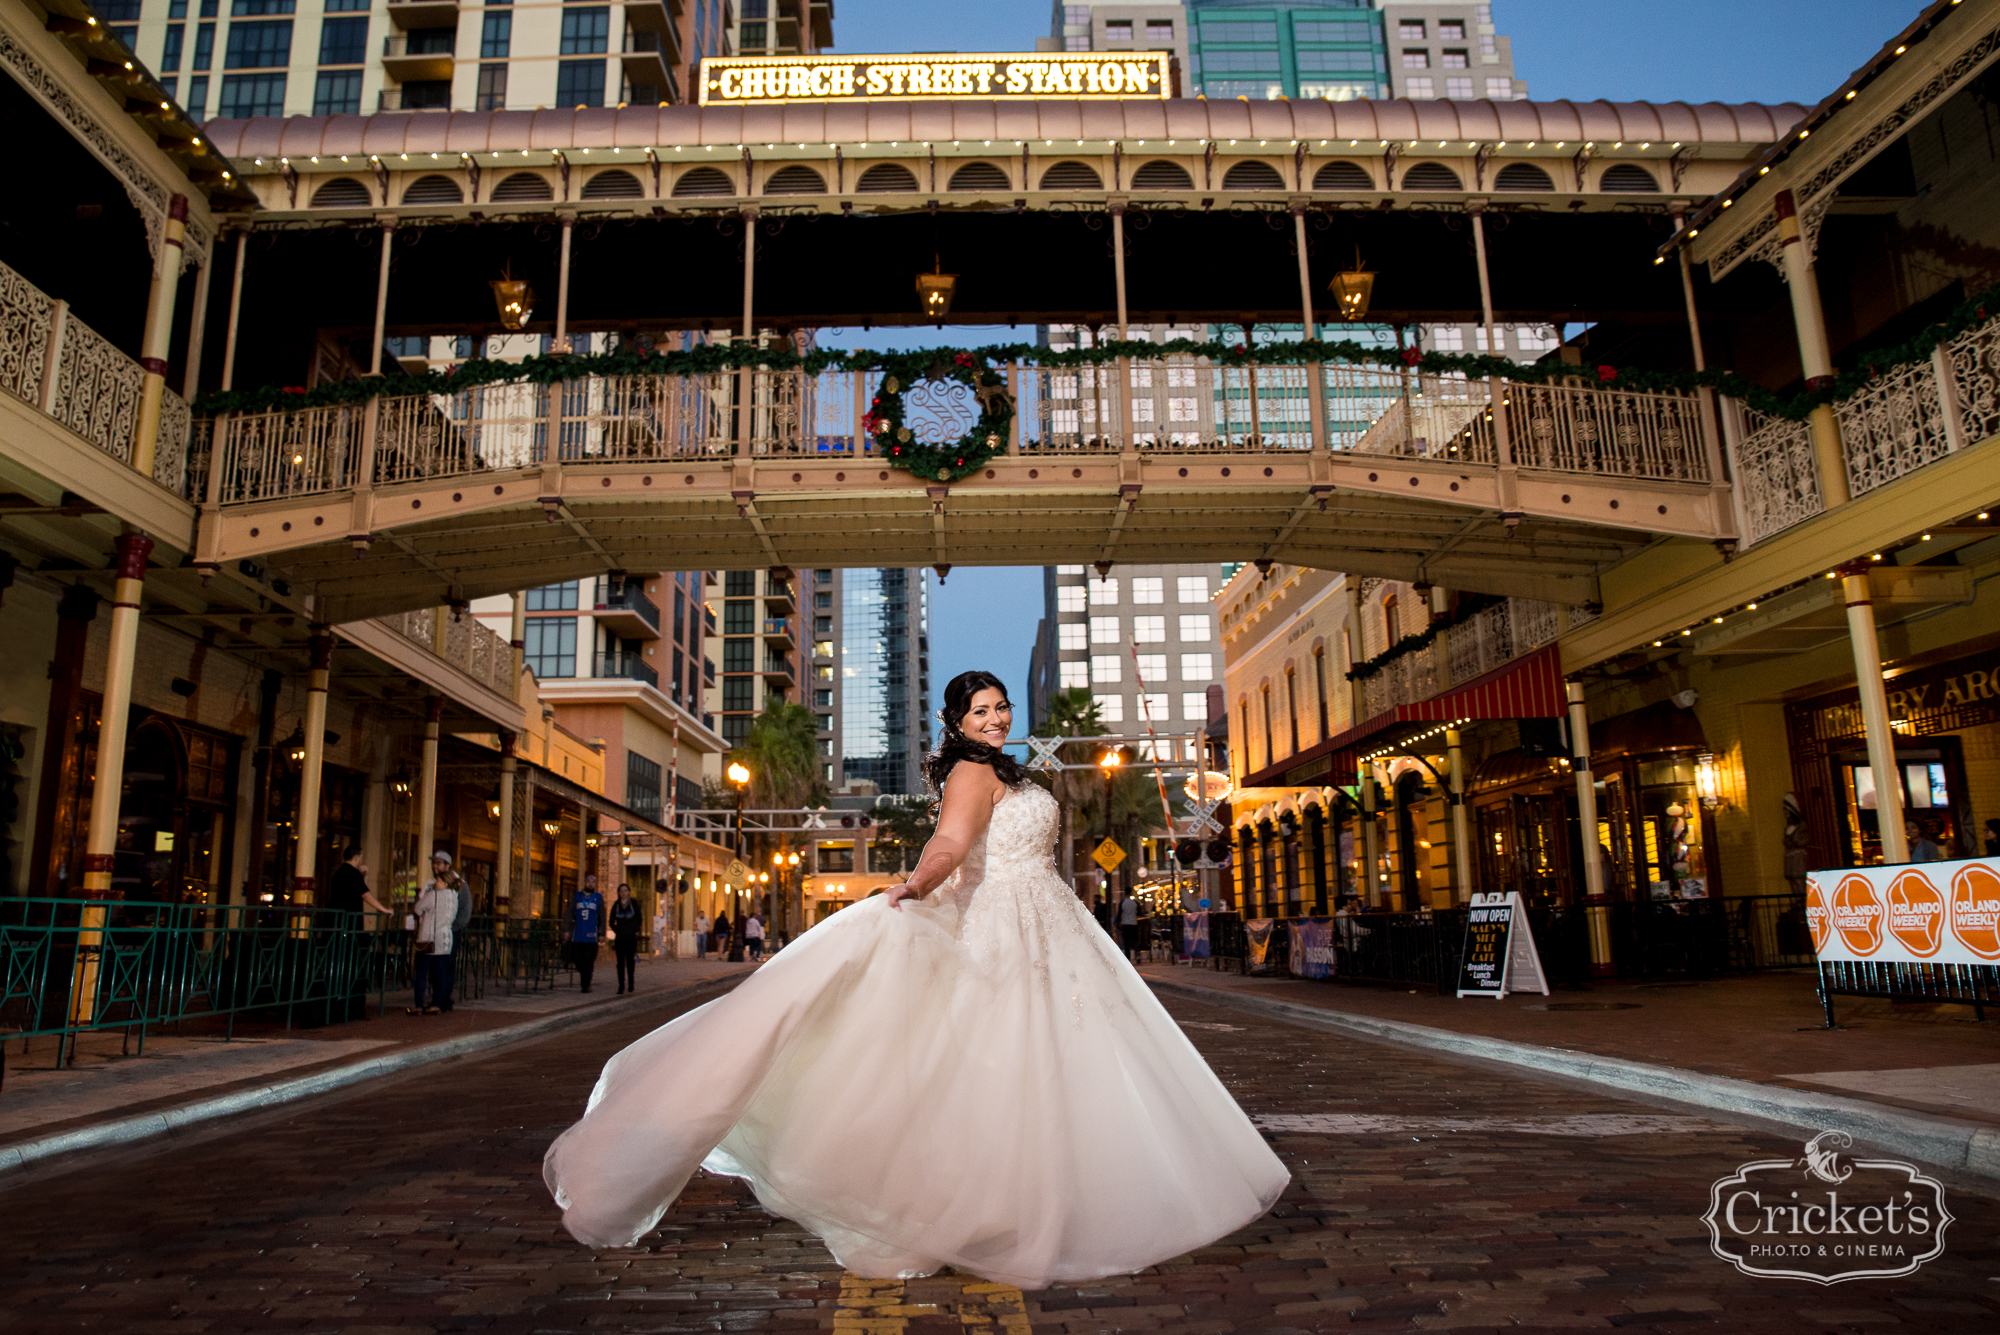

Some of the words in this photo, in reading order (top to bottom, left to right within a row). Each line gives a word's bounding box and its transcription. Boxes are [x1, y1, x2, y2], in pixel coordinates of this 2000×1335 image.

[720, 65, 856, 98] CHURCH
[866, 63, 996, 95] STREET
[1006, 61, 1150, 93] STATION
[1837, 904, 1880, 916] ORLANDO
[1893, 901, 1940, 915] ORLANDO
[1955, 899, 2000, 913] ORLAND
[1470, 910, 1489, 922] NOW
[1490, 909, 1511, 922] OPEN
[1838, 916, 1873, 927] WEEKLY
[1893, 914, 1932, 926] WEEKLY
[1956, 912, 2000, 925] WEEKLY
[1471, 924, 1506, 933] MARY'S
[1471, 953, 1496, 962] CAFE
[1467, 963, 1495, 971] Breakfast
[1473, 971, 1491, 979] Lunch
[1480, 979, 1500, 987] Dinner
